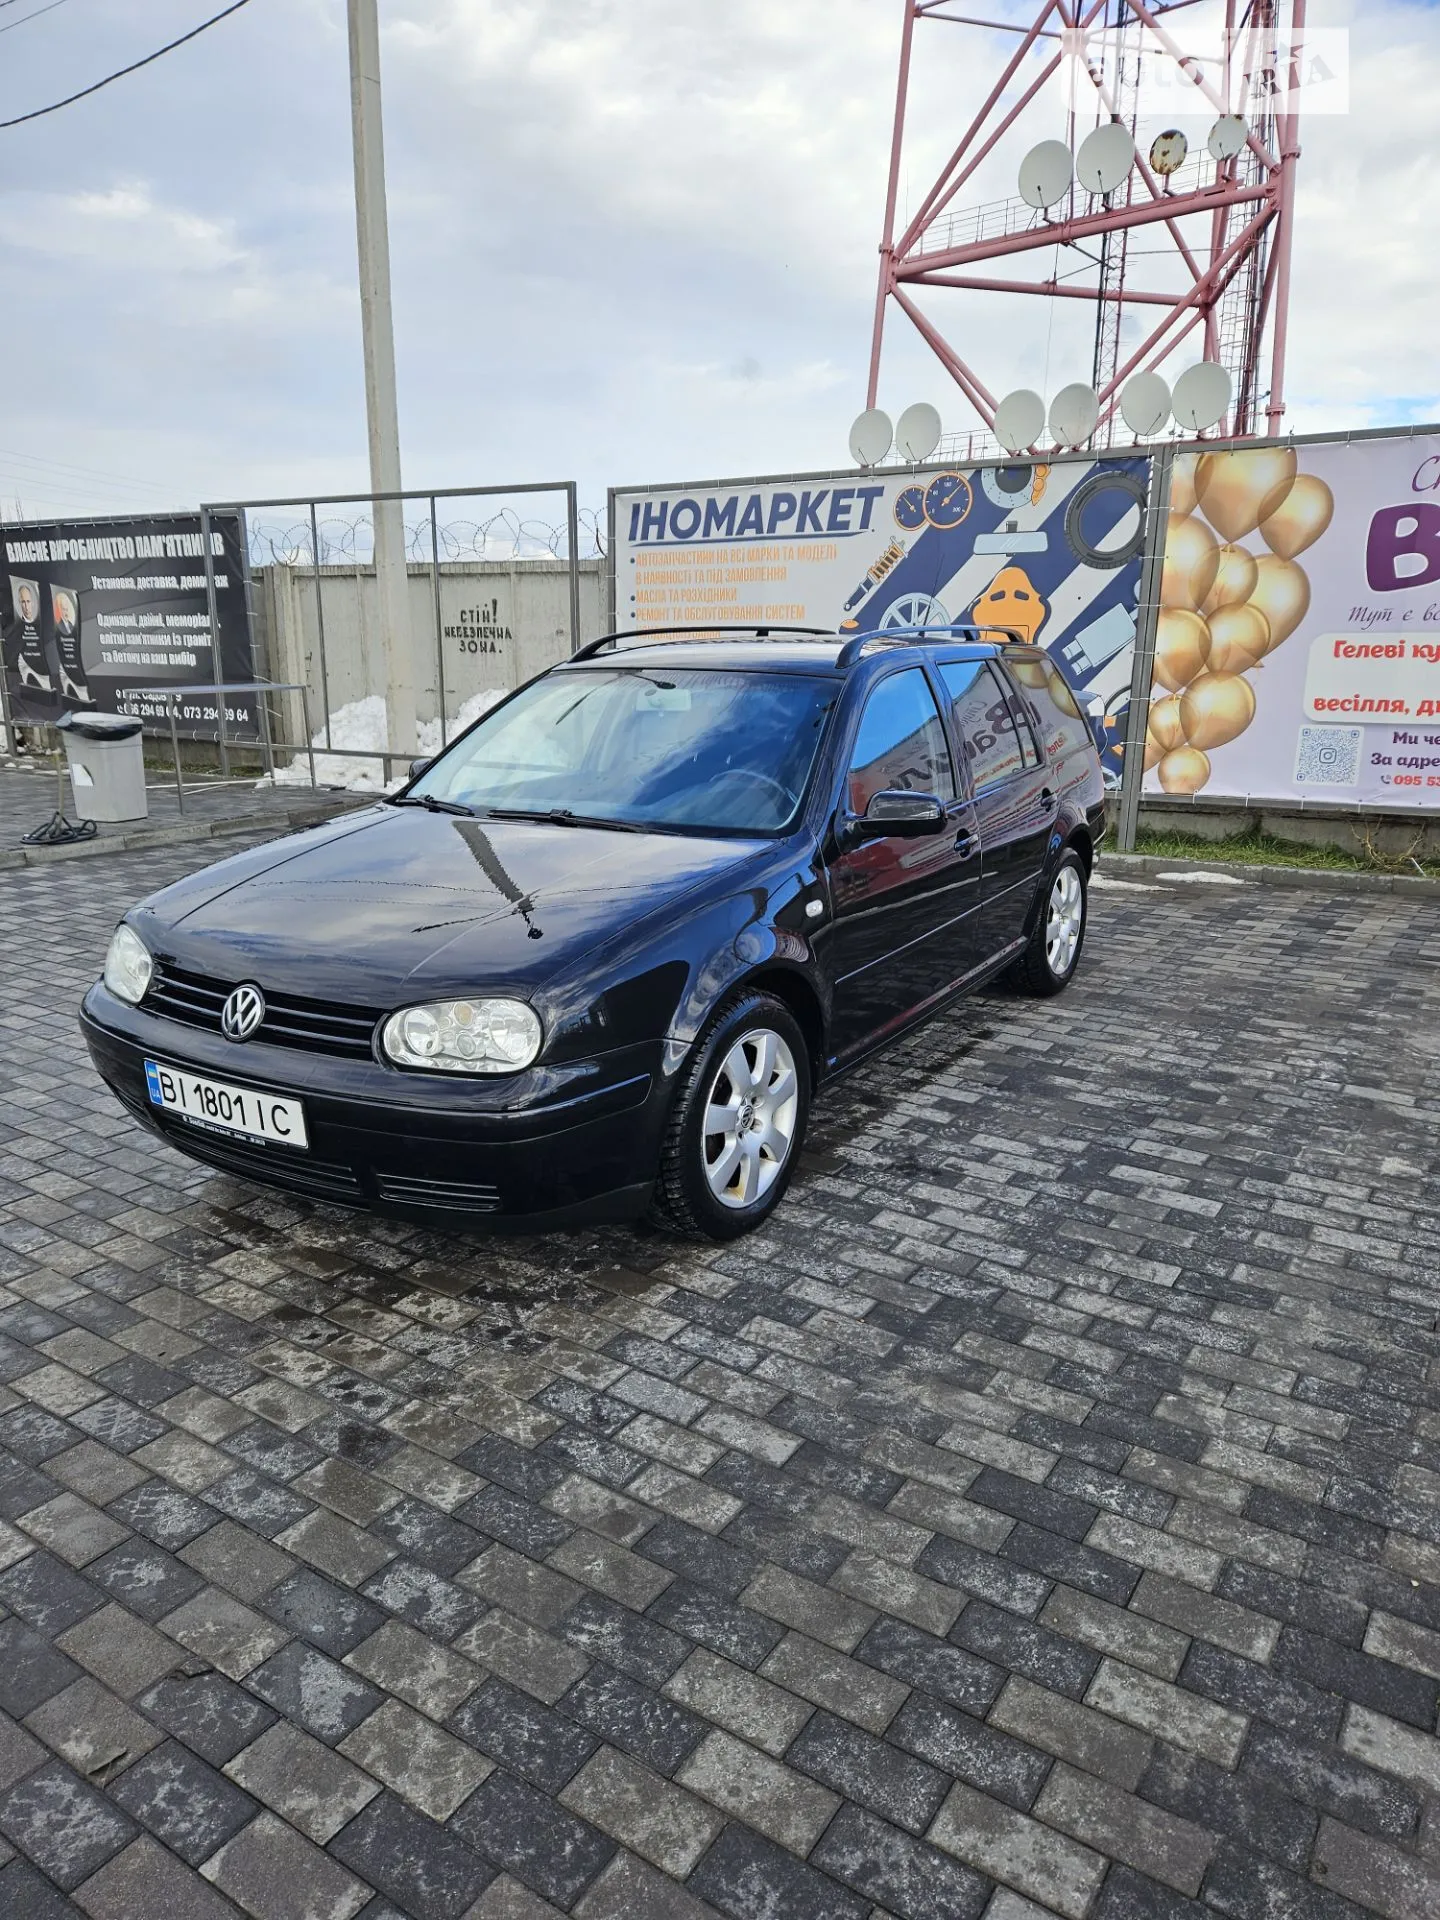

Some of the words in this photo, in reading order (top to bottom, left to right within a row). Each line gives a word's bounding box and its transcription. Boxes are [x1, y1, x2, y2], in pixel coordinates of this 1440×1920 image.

[1412, 455, 1440, 492] С
[628, 486, 884, 541] ІНОМАРКЕТ
[6, 541, 50, 563] ВЛАСНЕ
[49, 537, 135, 563] ВИРОБНИЦТВО
[135, 533, 225, 558] ПАМ'ЯТНИІВ
[748, 545, 779, 561] МАРКИ
[783, 545, 794, 560] ТА
[695, 568, 704, 583] ТА
[727, 566, 787, 582] ЗАМОВЛЕННЯ
[669, 588, 680, 602] ТА
[636, 606, 669, 621] РЕМОНТ
[672, 606, 682, 621] ТА
[766, 603, 804, 620] СИСТЕМ
[444, 626, 513, 640] НЕБЕЗПЕЧНА
[459, 640, 503, 654] ЗОНА.
[1333, 639, 1406, 659] Гелеві
[169, 651, 197, 667] вибір
[1313, 694, 1410, 715] весілля,
[183, 706, 201, 719] 073
[236, 708, 249, 722] 64
[1392, 731, 1418, 745] Ми
[1371, 753, 1392, 765] За
[1394, 775, 1422, 786] 095
[159, 1072, 187, 1108] BI
[193, 1083, 247, 1126] 1801
[256, 1099, 292, 1136] IC
